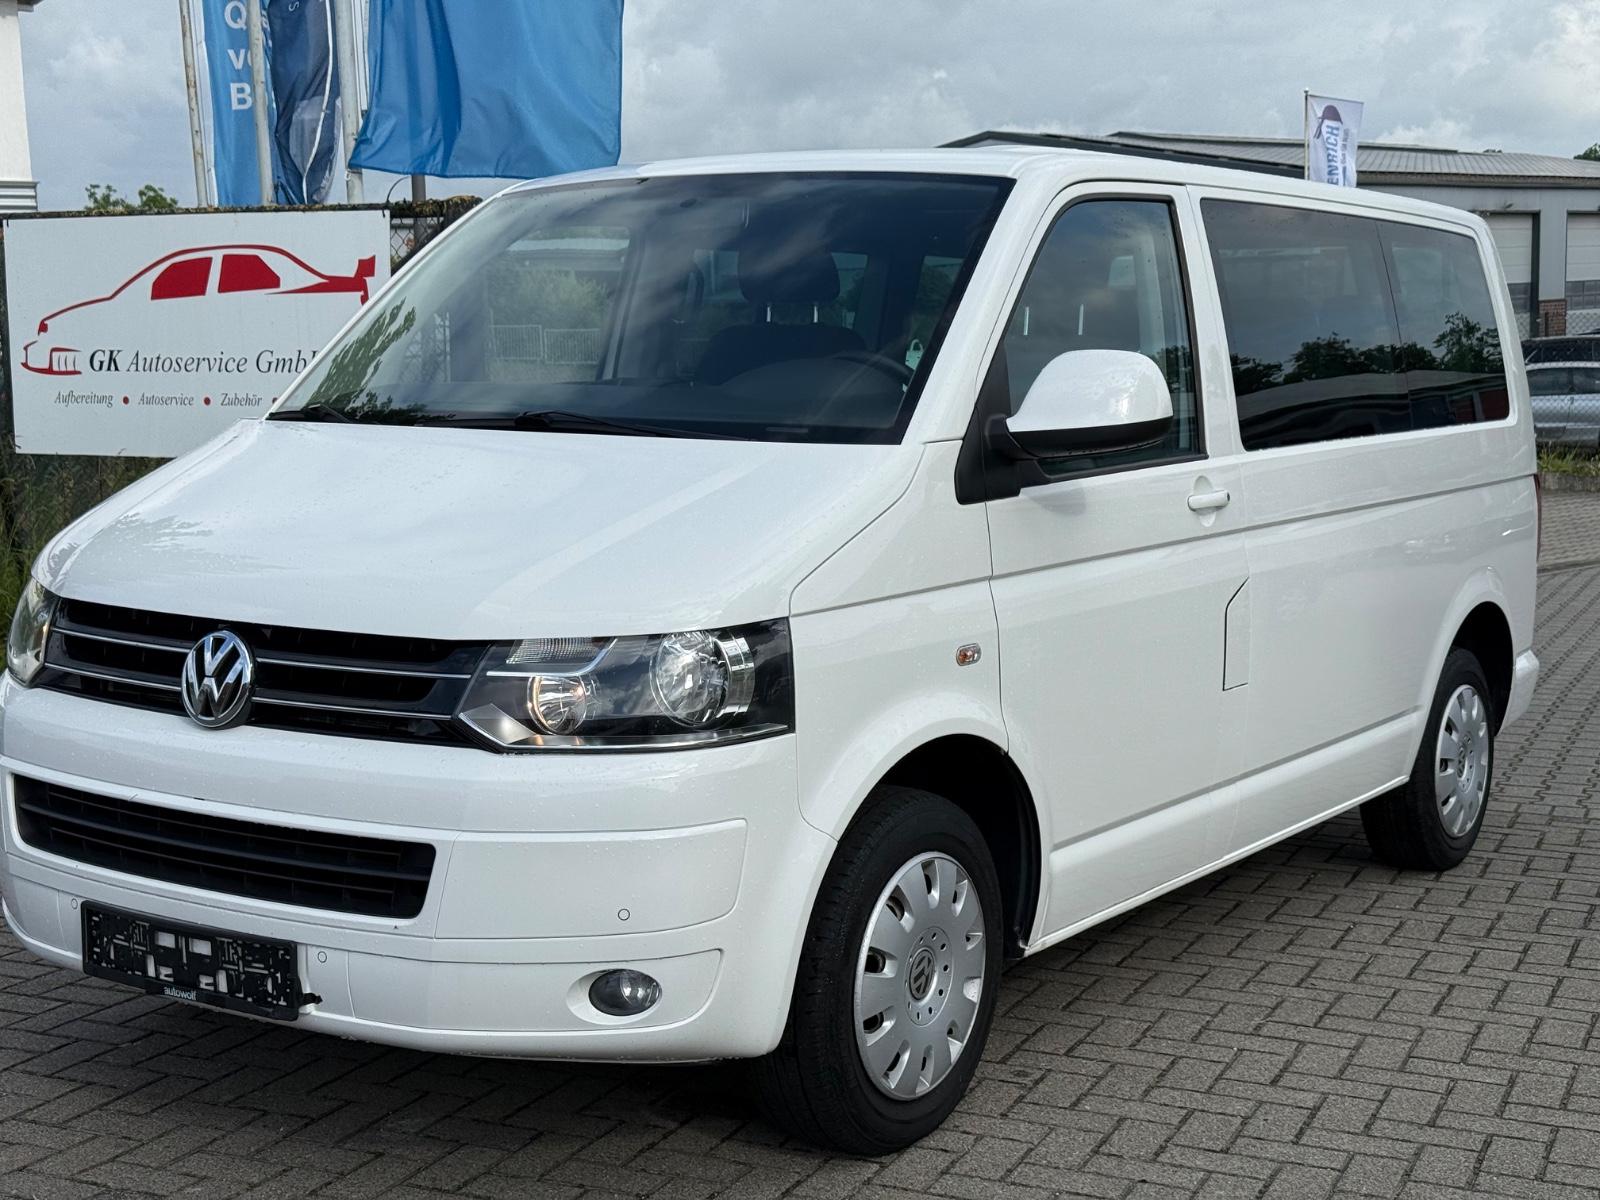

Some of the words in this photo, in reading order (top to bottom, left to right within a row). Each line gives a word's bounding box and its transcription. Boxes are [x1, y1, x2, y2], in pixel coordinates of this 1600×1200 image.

[89, 349, 123, 372] GK
[126, 350, 248, 374] Autoservice
[256, 349, 319, 374] Gmb
[54, 390, 114, 409] Aufbereitung
[138, 392, 194, 407] Autoservice
[220, 392, 263, 408] Zubehör
